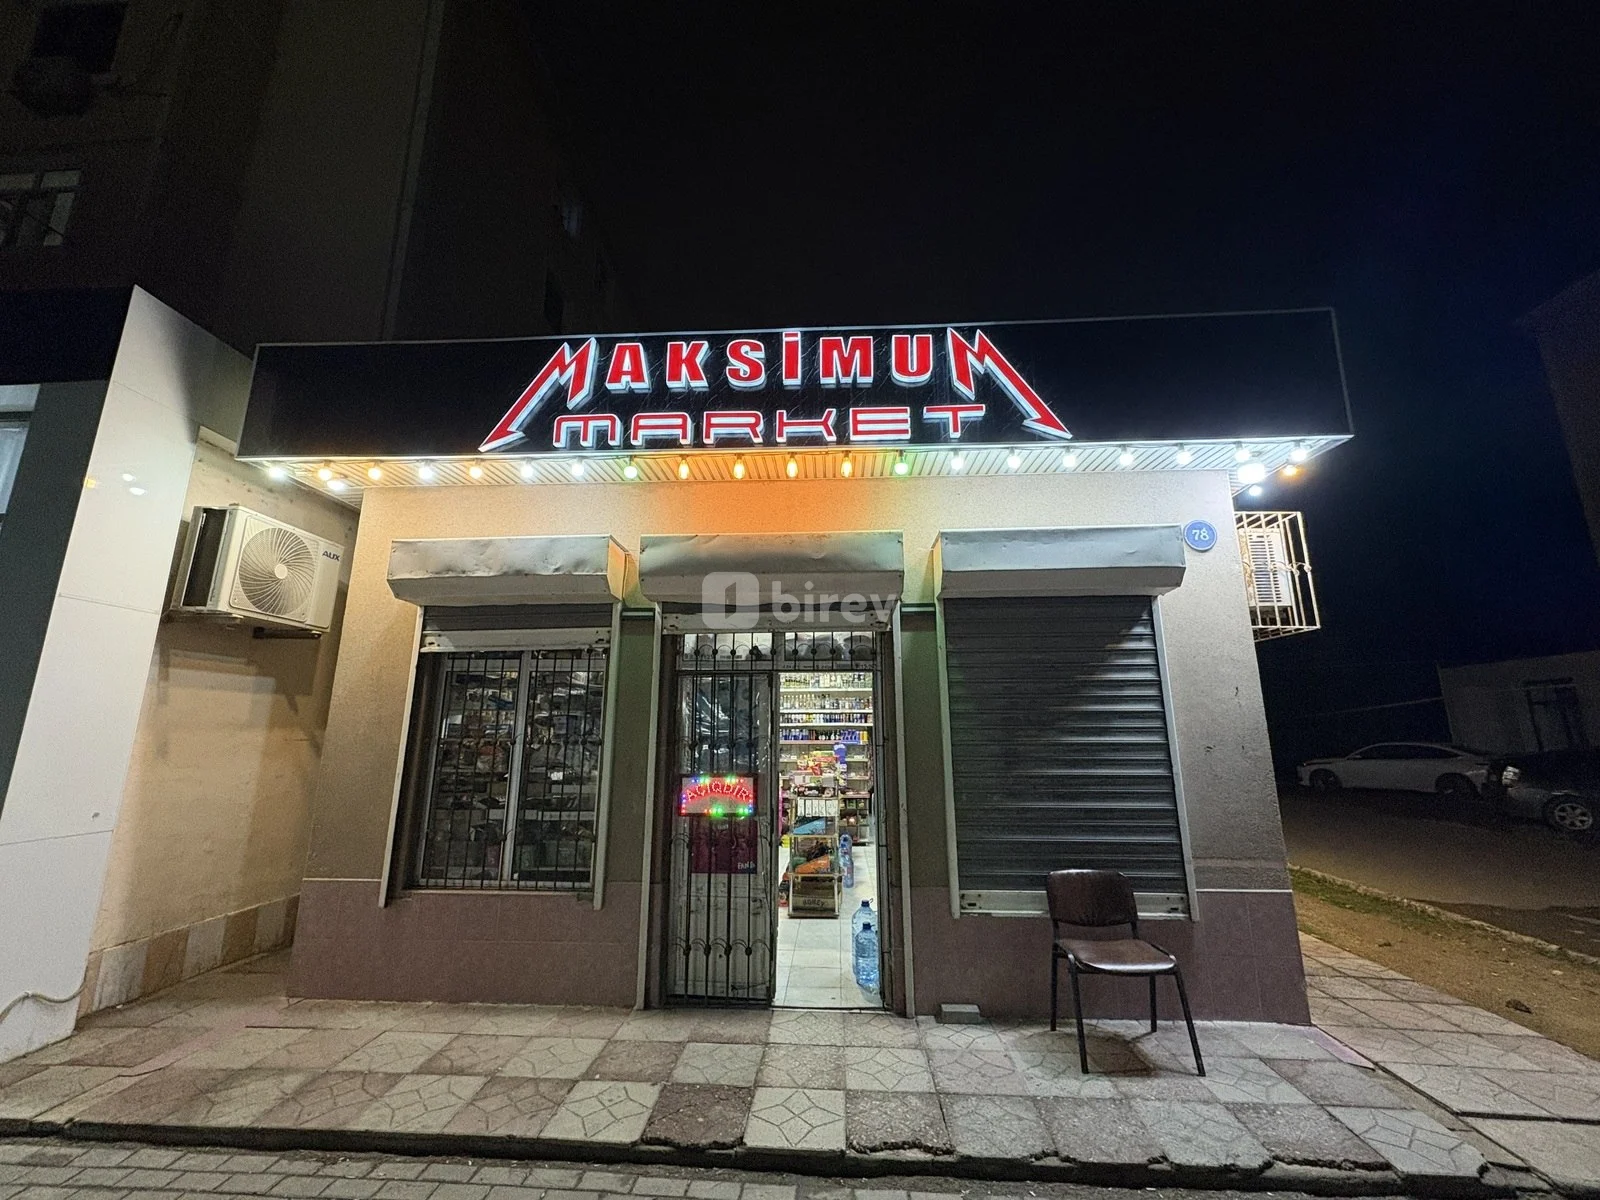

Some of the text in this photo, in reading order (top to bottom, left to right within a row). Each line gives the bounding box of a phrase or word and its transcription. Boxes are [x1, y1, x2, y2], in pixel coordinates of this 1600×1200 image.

[478, 326, 1073, 453] MAKSİMUM
[553, 403, 986, 449] MARKET
[1191, 527, 1209, 541] 78
[322, 550, 340, 561] AUX
